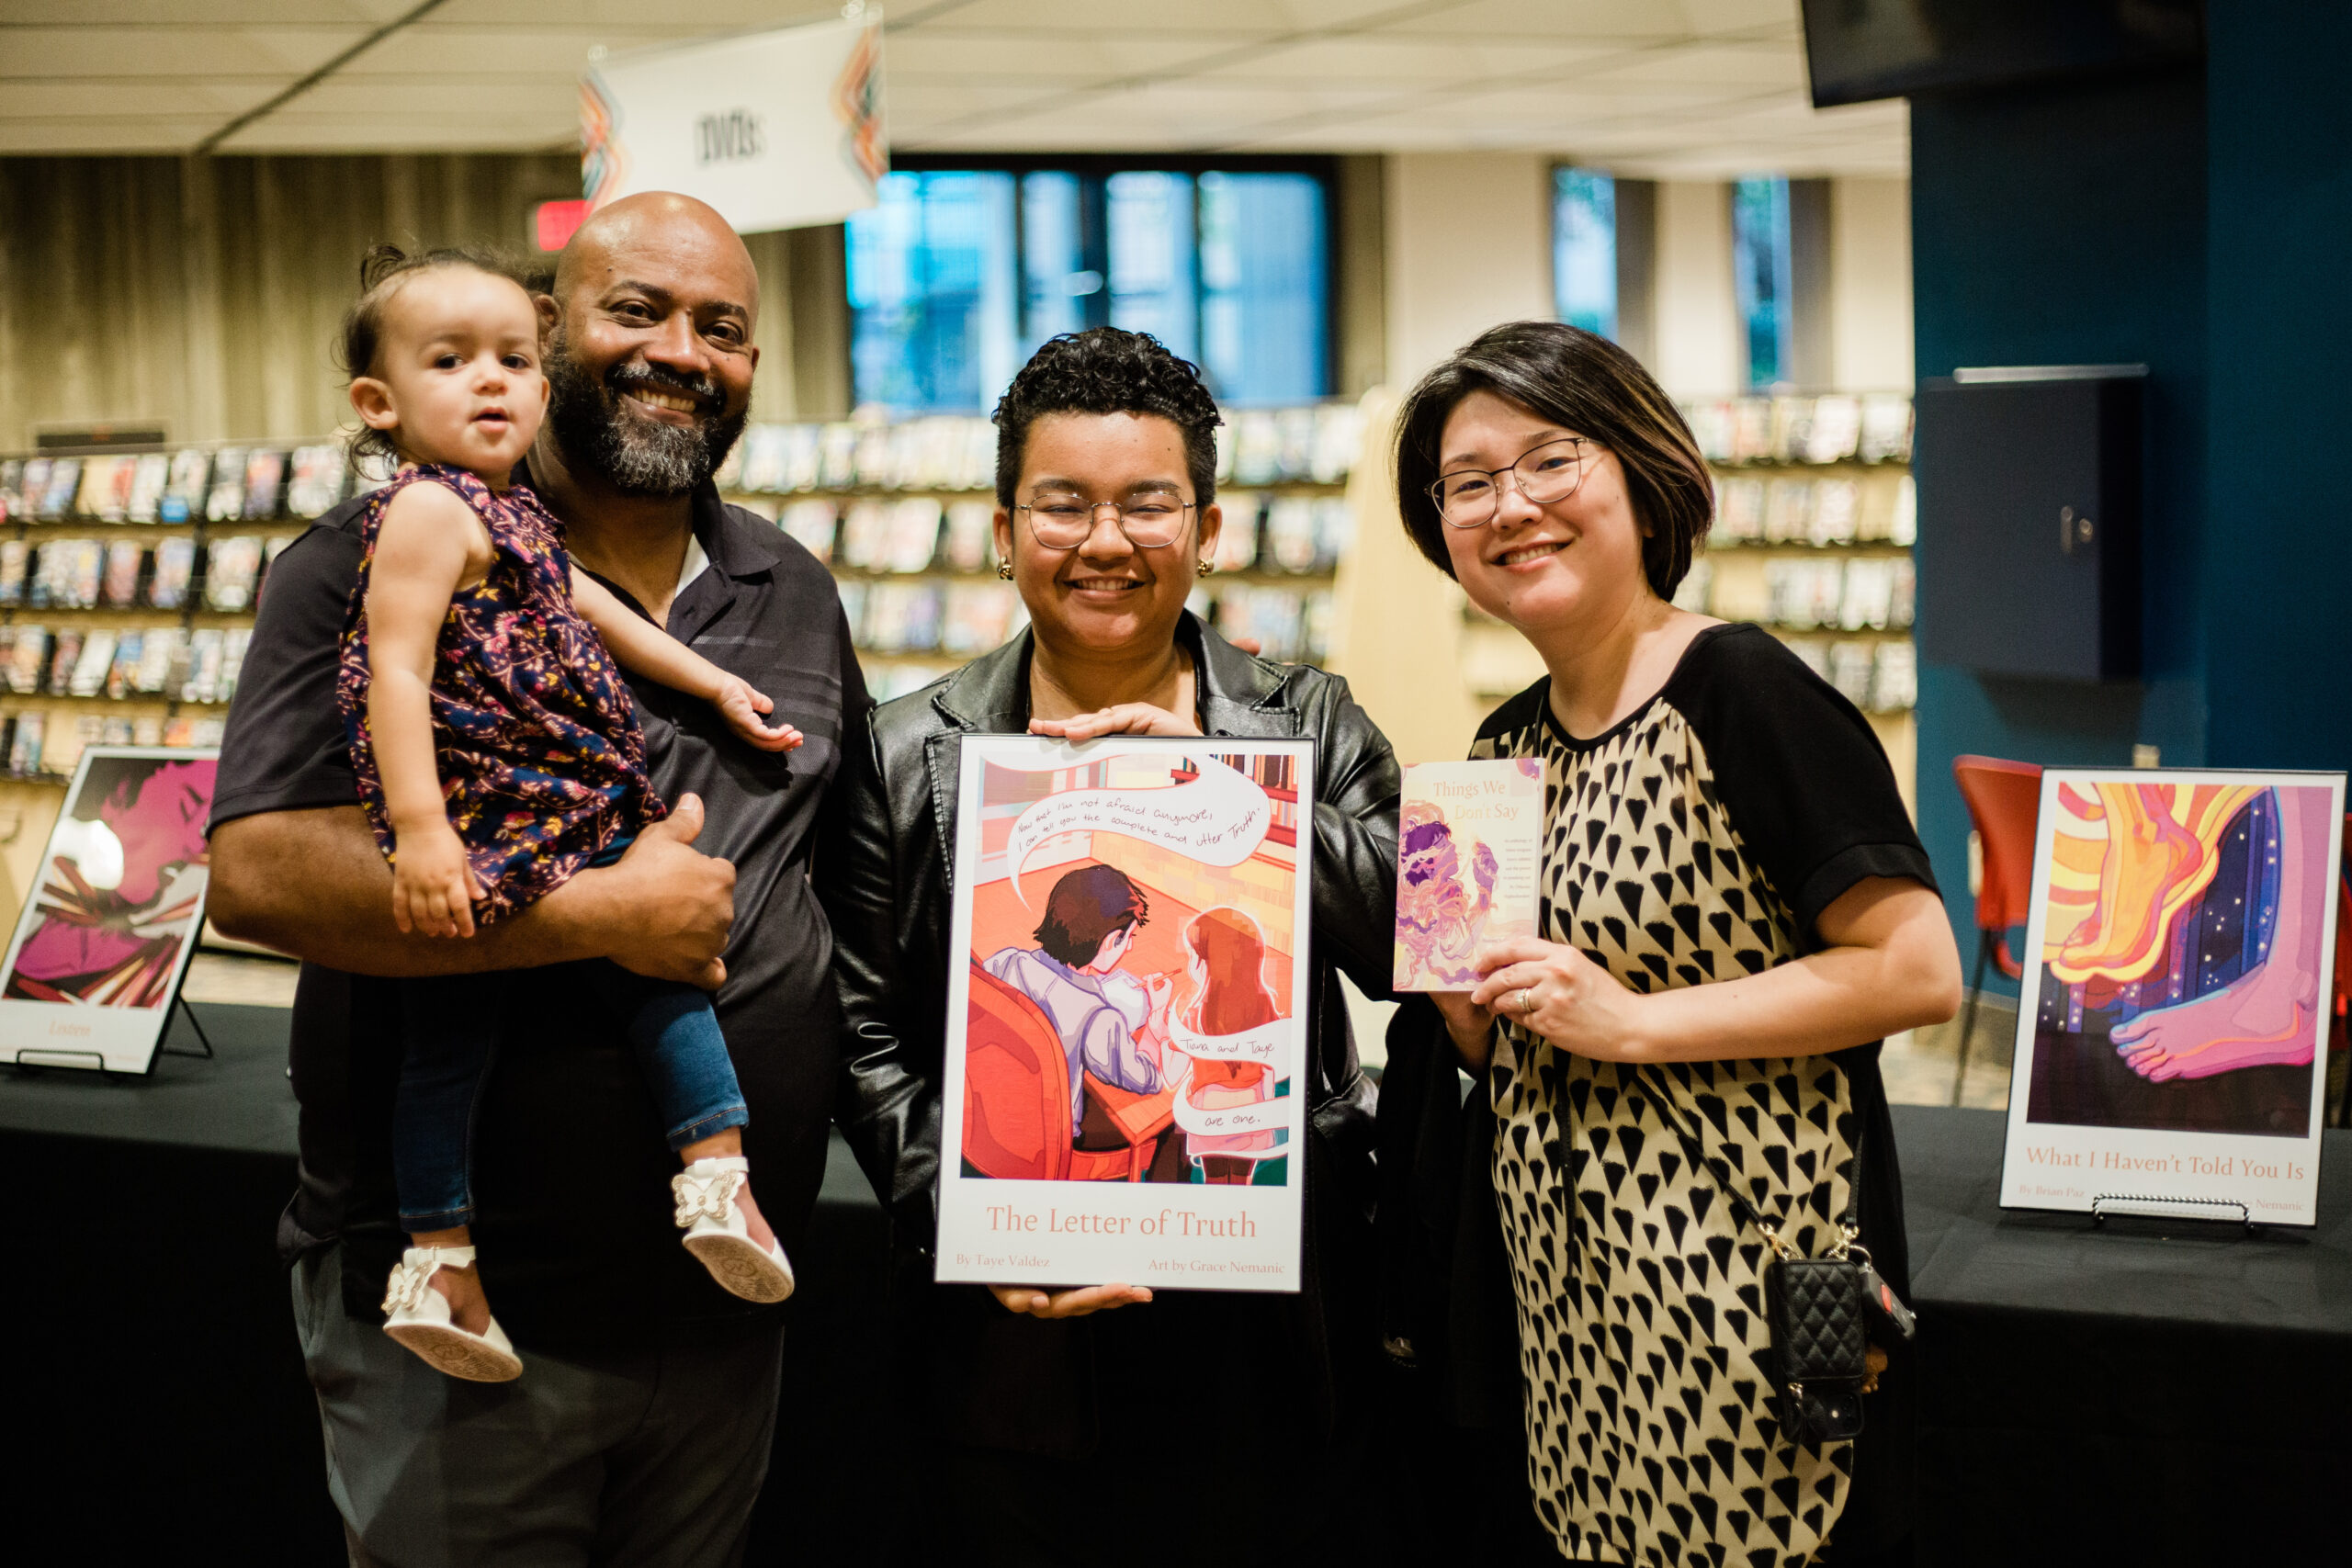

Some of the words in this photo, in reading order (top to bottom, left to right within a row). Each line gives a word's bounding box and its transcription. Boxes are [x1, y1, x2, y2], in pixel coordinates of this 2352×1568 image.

[1433, 781, 1478, 799] Things
[1483, 780, 1506, 795] We
[1080, 797, 1100, 807] not
[1106, 797, 1146, 815] afraid
[1153, 808, 1213, 827] anymore,
[1454, 803, 1491, 820] Don't
[1495, 803, 1520, 821] Say
[1026, 835, 1038, 847] can
[1043, 822, 1054, 832] tell
[1060, 816, 1077, 827] you
[1083, 813, 1101, 822] the
[1111, 816, 1159, 836] complete
[1164, 831, 1187, 844] and
[1196, 832, 1223, 847] utter
[1227, 807, 1261, 840] Truth.
[1180, 1038, 1210, 1052] Tiana
[1217, 1042, 1239, 1053] and
[1246, 1040, 1275, 1059] Taye
[1204, 1116, 1225, 1127] are
[1232, 1115, 1261, 1124] one.
[2027, 1146, 2082, 1168] What
[2089, 1150, 2096, 1168] I
[2104, 1151, 2182, 1173] Haven't
[2188, 1156, 2233, 1176] Told
[2241, 1159, 2278, 1179] You
[2287, 1161, 2304, 1180] Is
[2018, 1184, 2031, 1197] By
[2035, 1185, 2064, 1197] Brian
[2256, 1198, 2304, 1212] Nemanic
[987, 1204, 1038, 1232] The
[1048, 1207, 1131, 1235] Letter
[1139, 1208, 1172, 1235] of
[1177, 1210, 1257, 1238] Truth
[956, 1253, 971, 1269] By
[975, 1254, 1005, 1269] Taye
[1007, 1255, 1050, 1268] Valdez
[1148, 1258, 1169, 1271] Art
[1172, 1258, 1187, 1275] by
[1190, 1259, 1227, 1272] Grace
[1229, 1260, 1285, 1274] Nemanic
